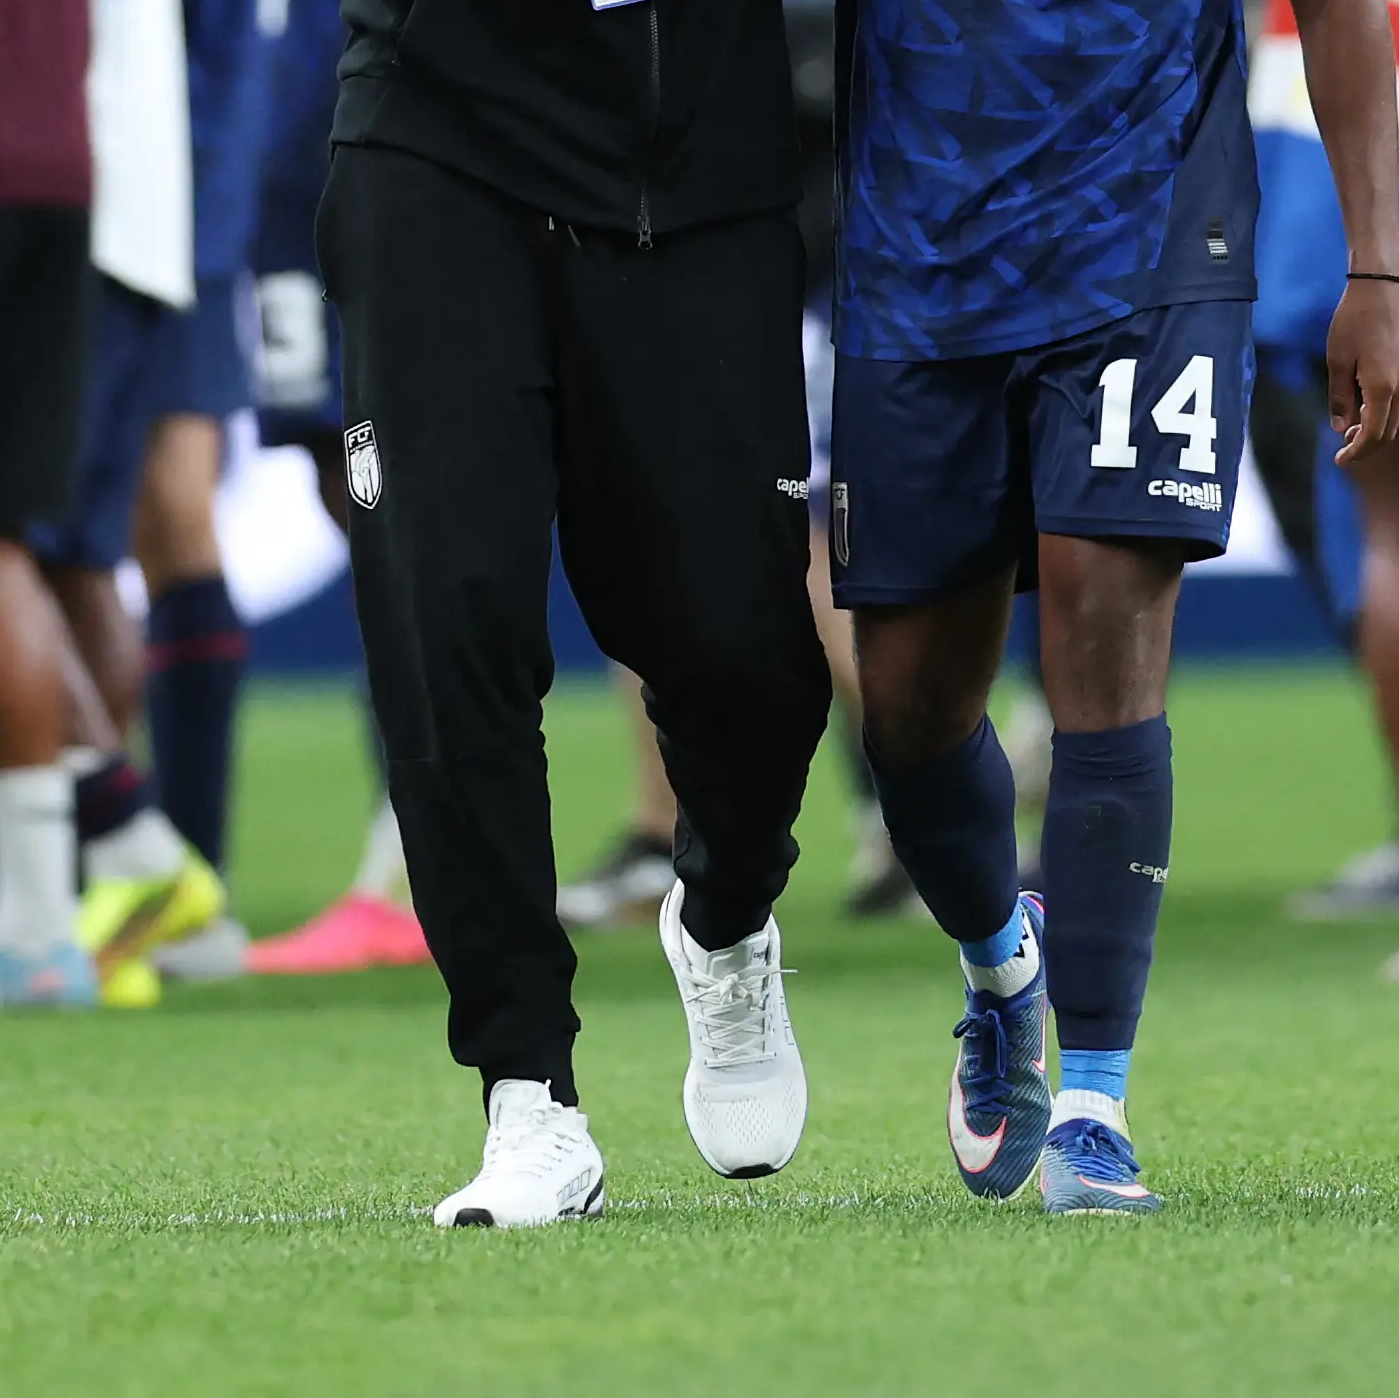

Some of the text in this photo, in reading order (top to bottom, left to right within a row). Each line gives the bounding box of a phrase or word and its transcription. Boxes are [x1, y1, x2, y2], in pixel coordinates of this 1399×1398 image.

[1090, 354, 1217, 474] 14
[1147, 479, 1222, 504] capelli
[1185, 497, 1223, 512] SPORT
